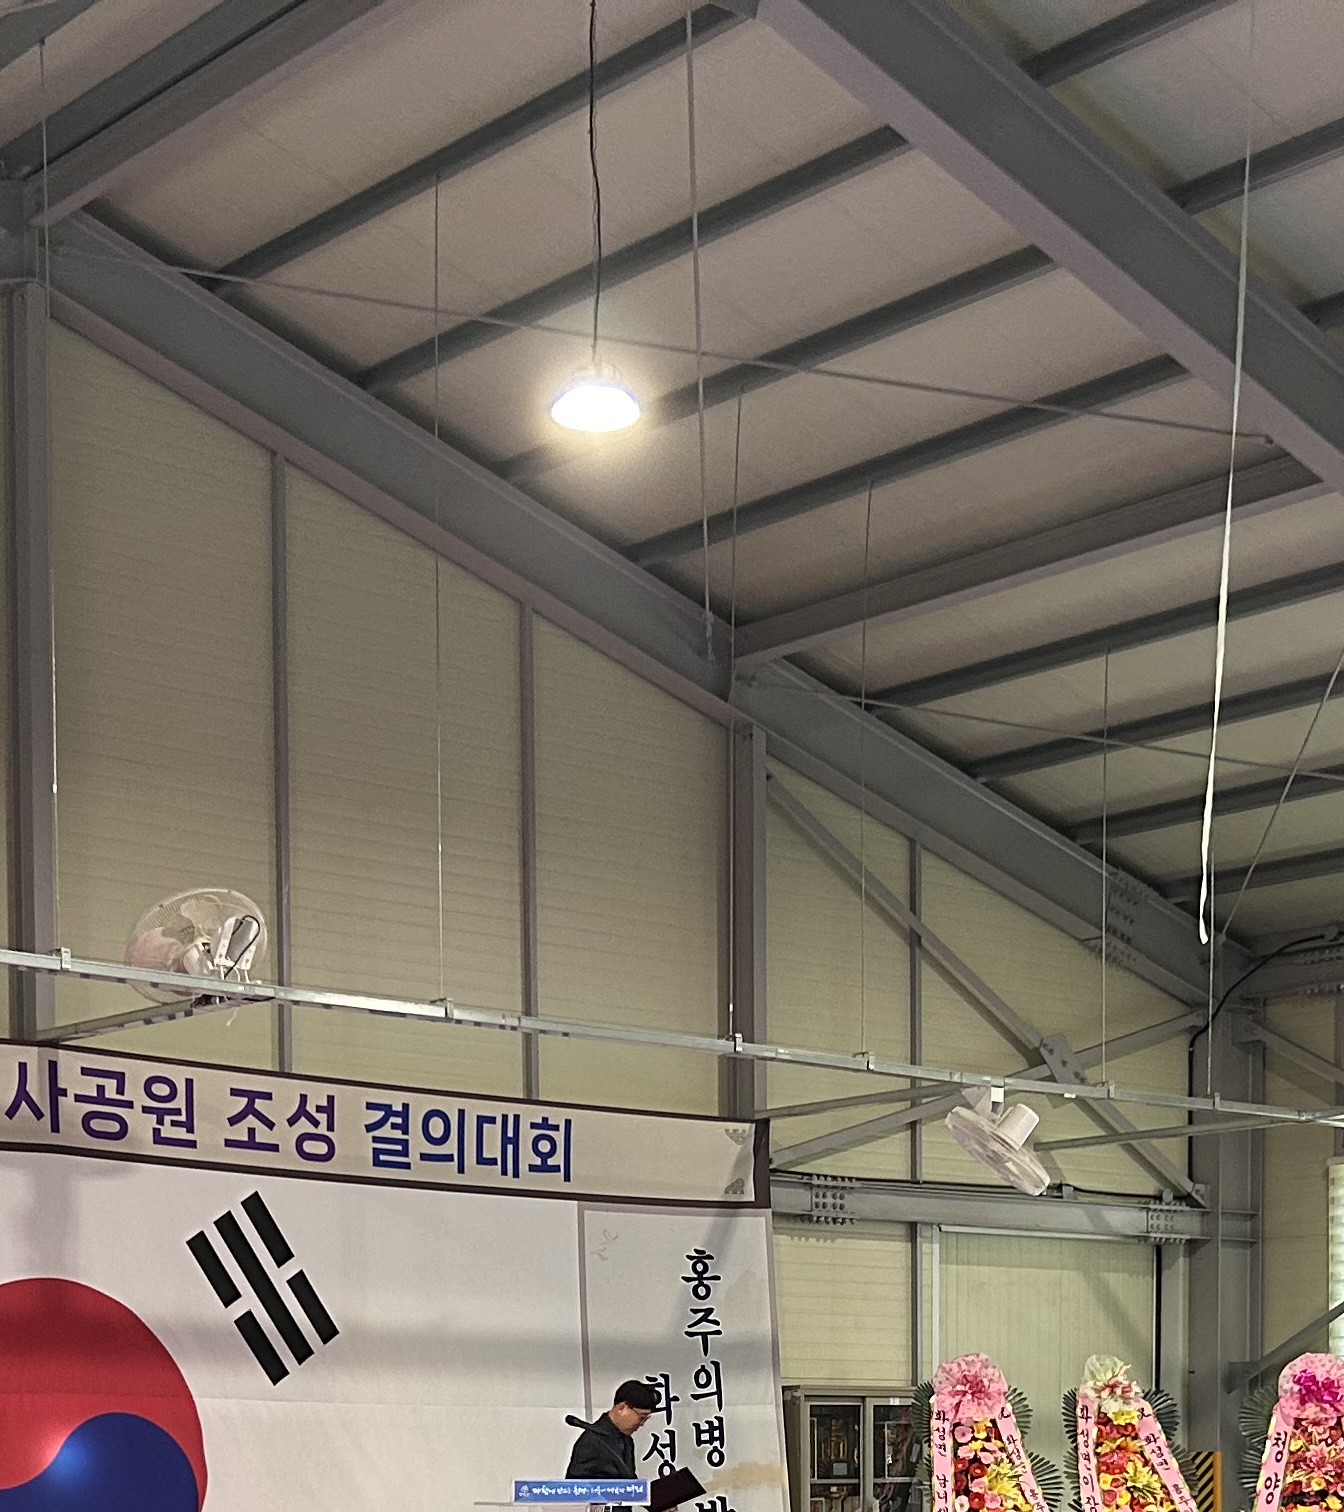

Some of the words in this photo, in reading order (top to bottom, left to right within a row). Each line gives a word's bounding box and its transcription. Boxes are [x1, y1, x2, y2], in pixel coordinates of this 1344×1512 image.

[224, 1086, 337, 1163] 조성
[364, 1101, 573, 1183] 결의대회
[681, 1248, 726, 1468] 홍주의병
